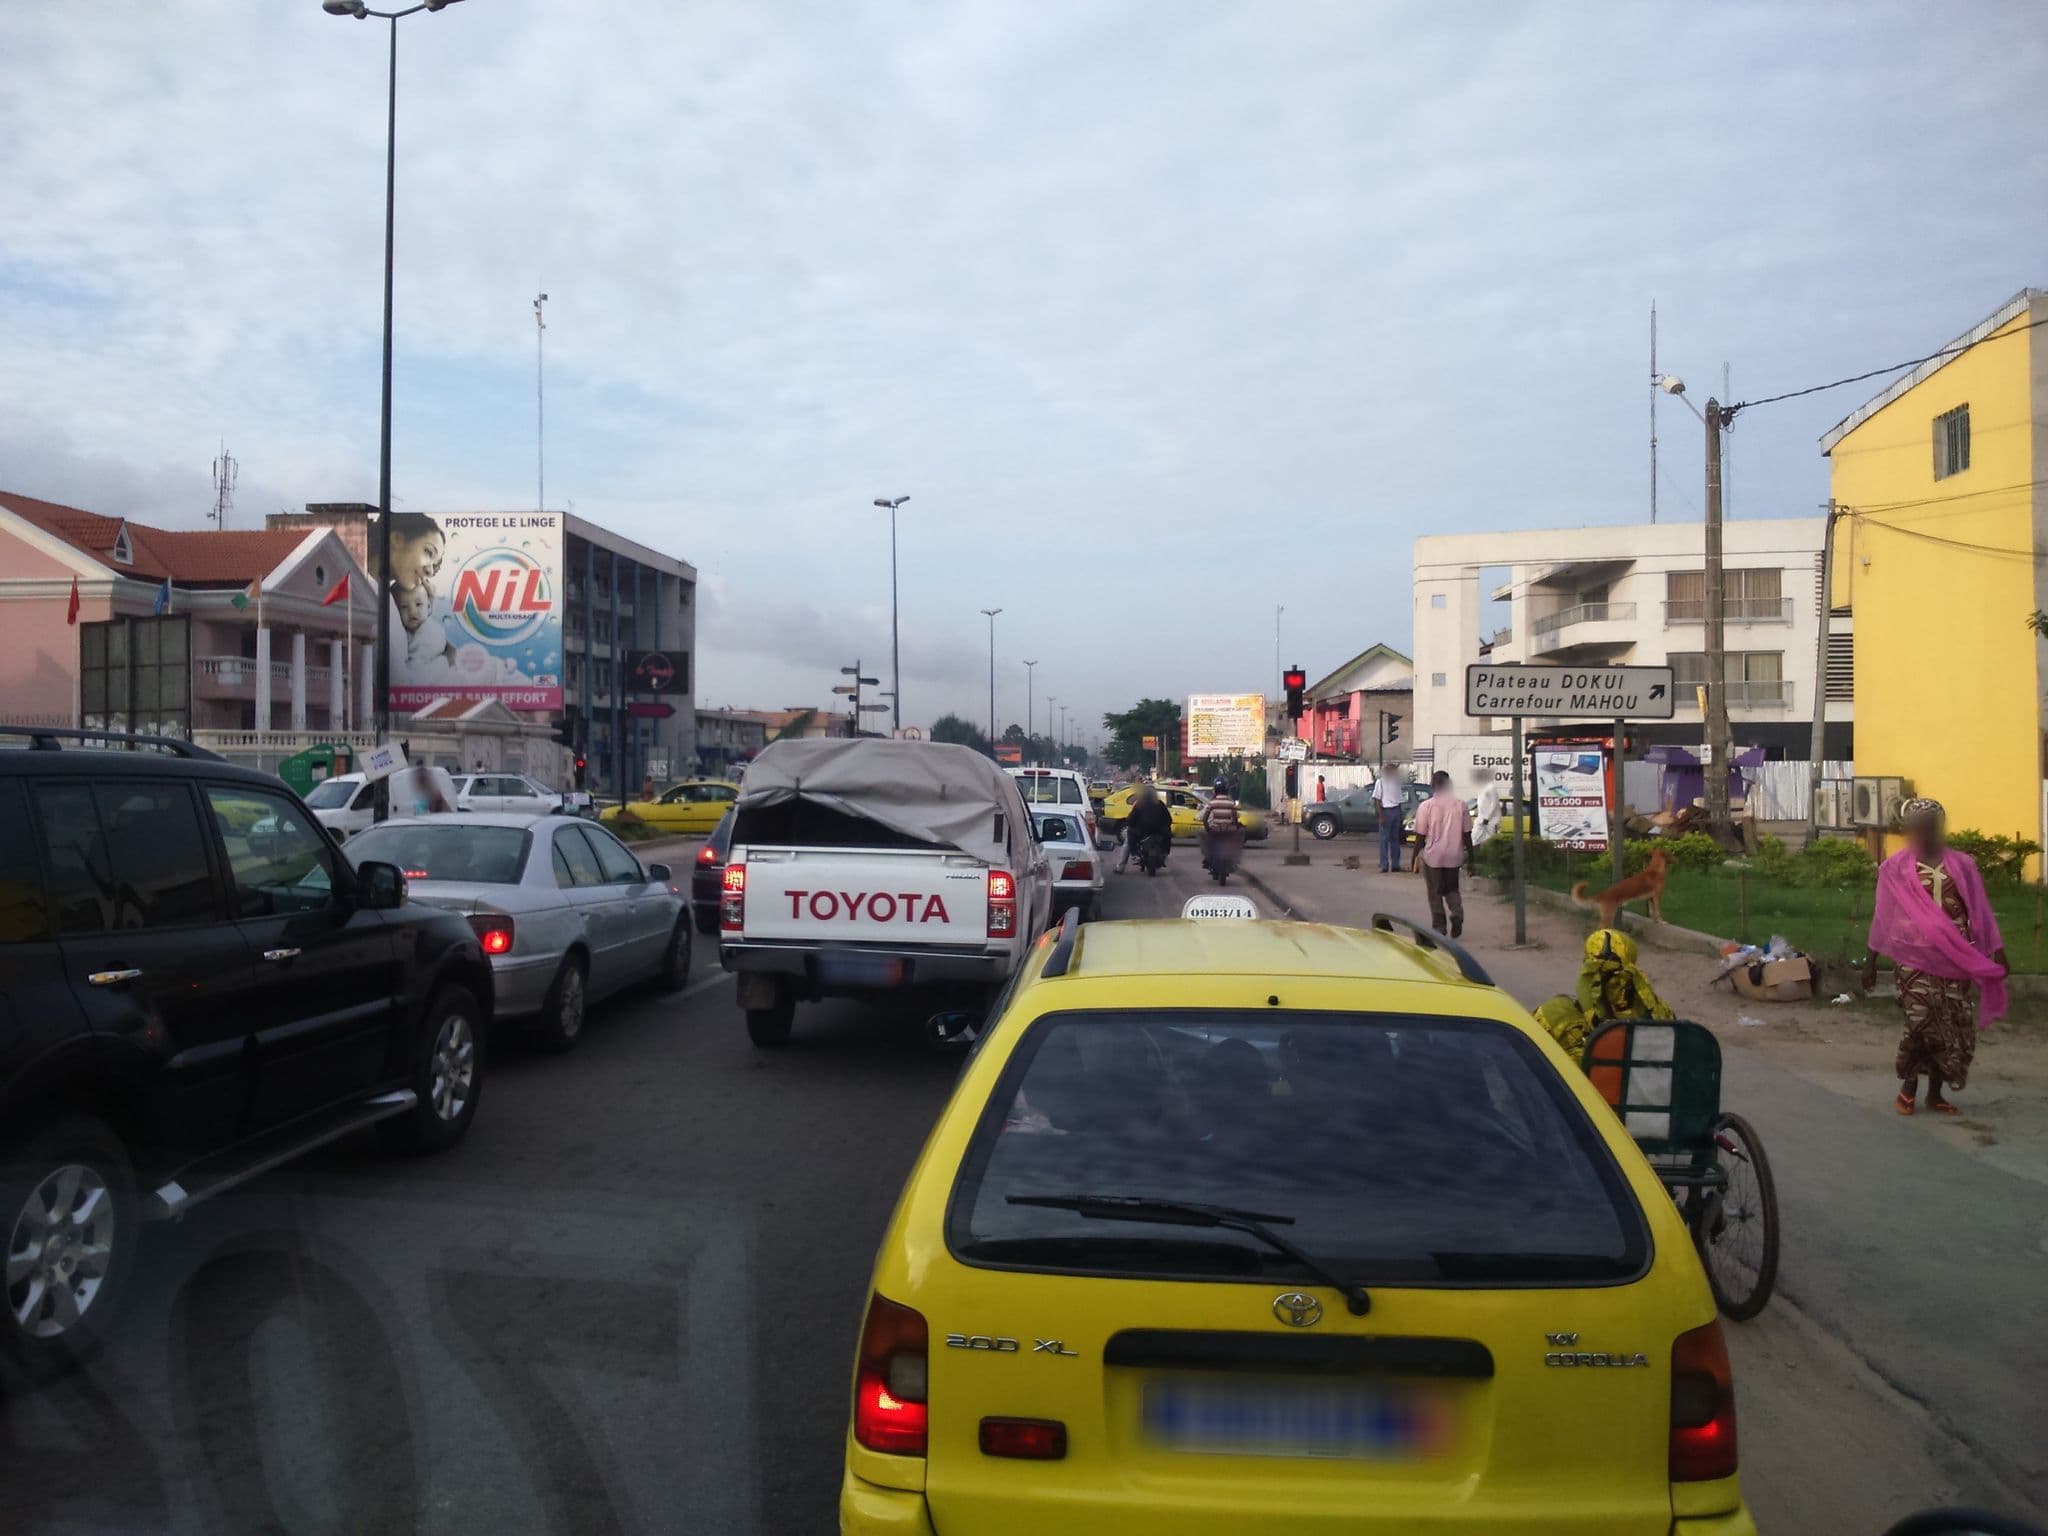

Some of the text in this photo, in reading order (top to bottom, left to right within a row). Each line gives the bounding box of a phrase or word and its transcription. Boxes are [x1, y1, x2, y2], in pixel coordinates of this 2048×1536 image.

[445, 517, 556, 528] PROTEGE LE LINGE
[1475, 673, 1625, 690] Plateau DOKUI
[501, 692, 549, 704] EFFORT
[1476, 693, 1638, 710] Carrefour MAHOU
[784, 890, 950, 924] TOYOTA
[1190, 908, 1252, 918] 0983/14
[1032, 1338, 1079, 1357] XL
[1545, 1352, 1651, 1368] COROLLA
